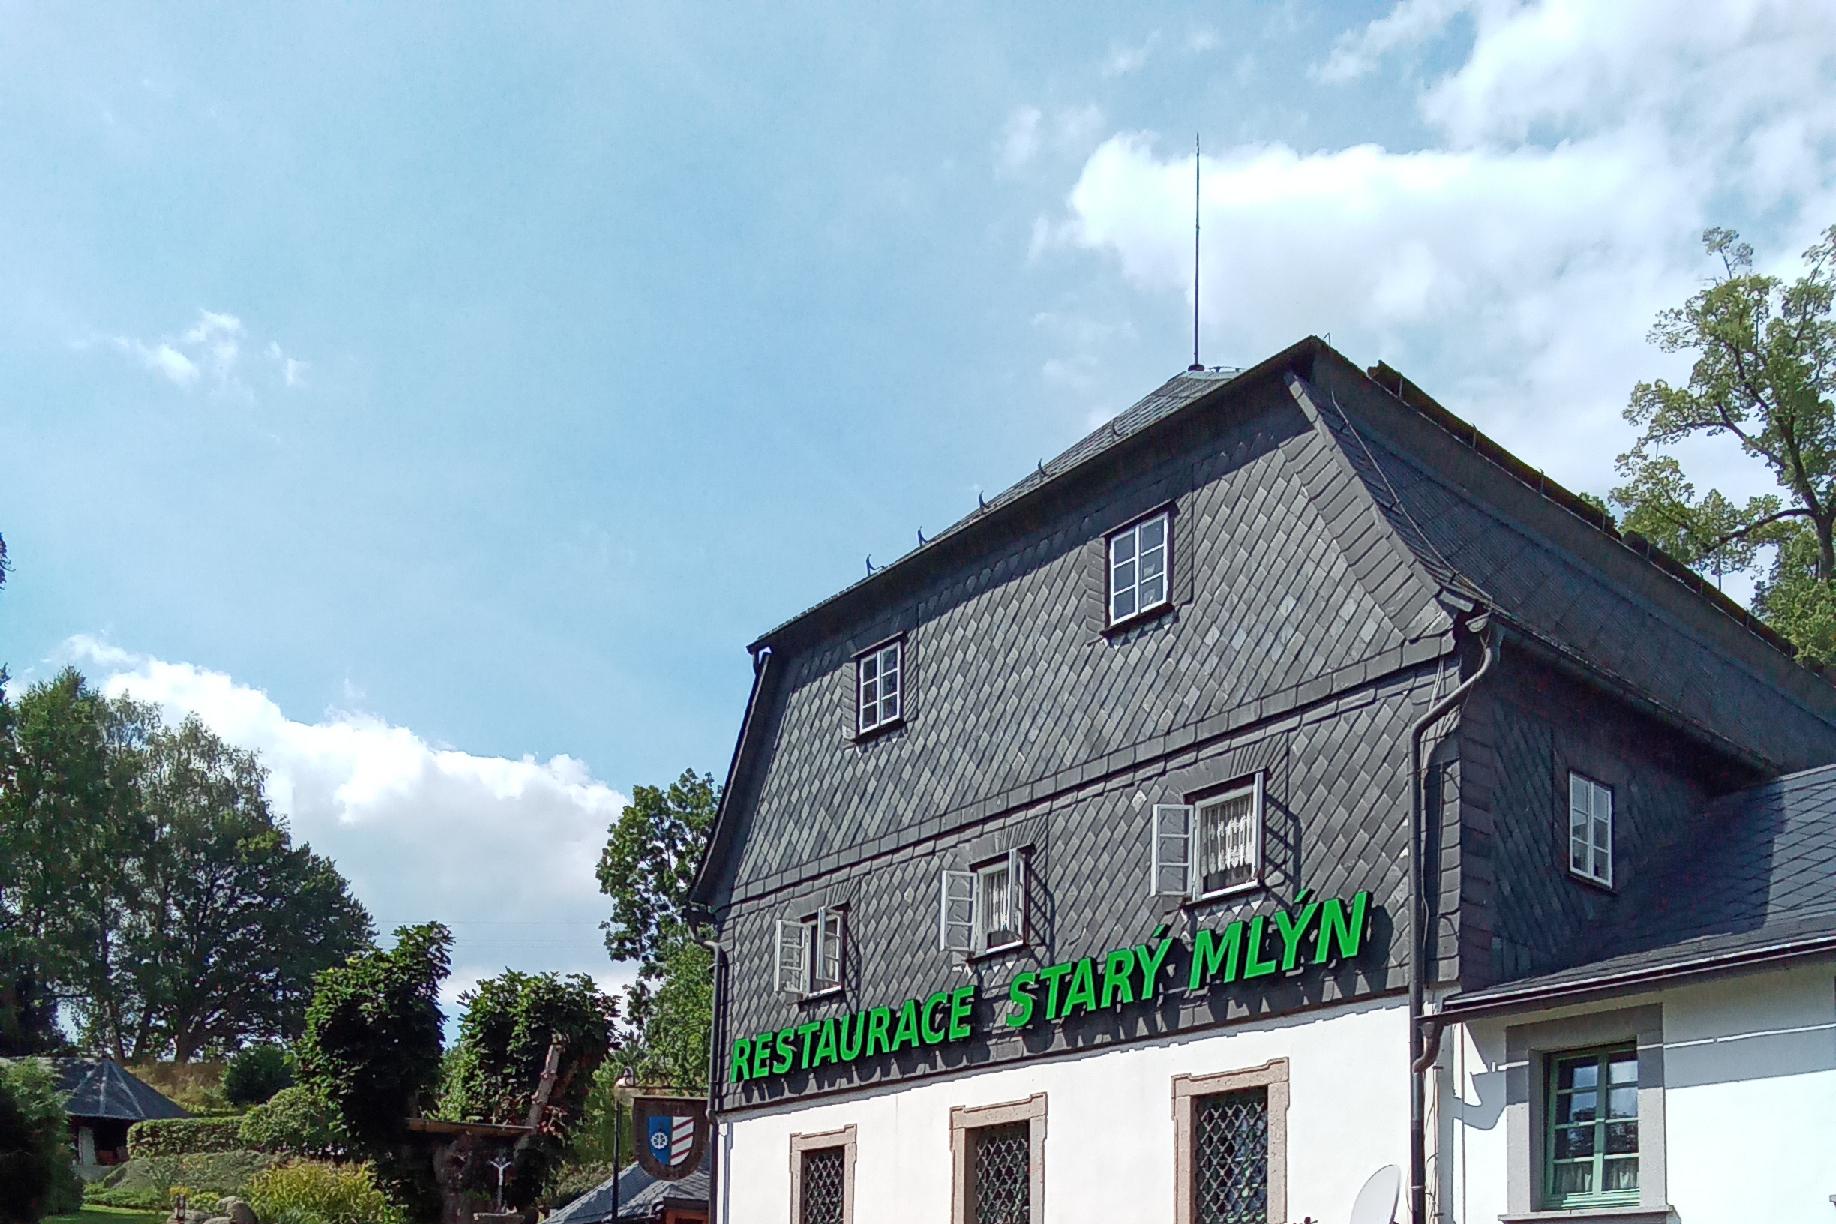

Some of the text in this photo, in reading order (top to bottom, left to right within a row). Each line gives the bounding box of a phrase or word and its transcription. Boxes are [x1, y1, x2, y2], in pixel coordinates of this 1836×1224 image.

[730, 890, 1369, 1082] RESTAURACE STARÝ MLÝN
